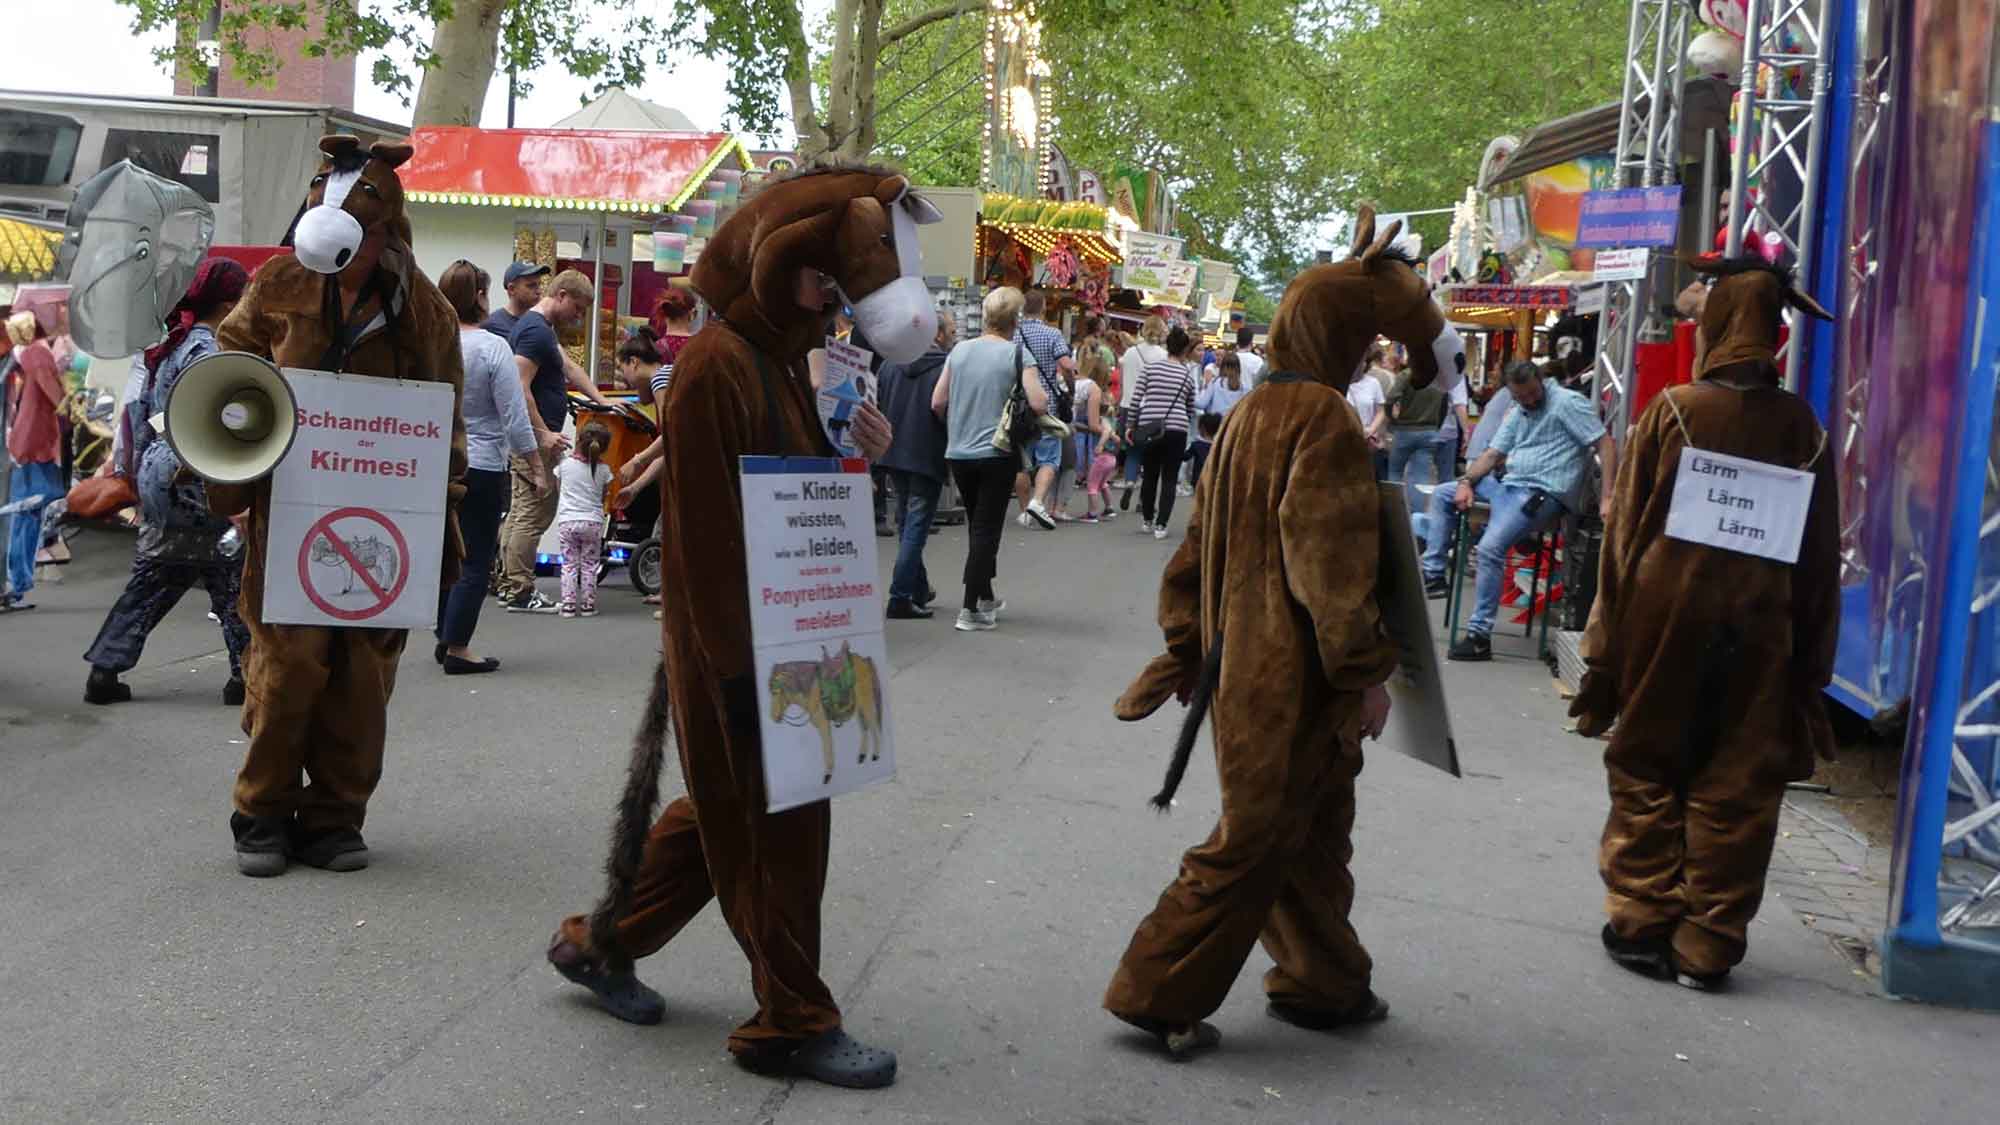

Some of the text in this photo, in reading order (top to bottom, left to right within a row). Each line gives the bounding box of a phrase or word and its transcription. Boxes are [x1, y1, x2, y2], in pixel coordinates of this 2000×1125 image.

[297, 408, 440, 439] Schandfleck
[358, 439, 376, 448] der
[311, 450, 418, 478] Kirmes!
[1691, 457, 1739, 480] Lärm
[802, 481, 852, 501] Kinder
[1707, 487, 1755, 511] Lärm
[787, 512, 846, 529] wüssten,
[1718, 517, 1766, 540] Lärm
[809, 537, 858, 559] leiden,
[762, 582, 873, 607] Ponyreitbahnen
[795, 608, 852, 632] meiden!
